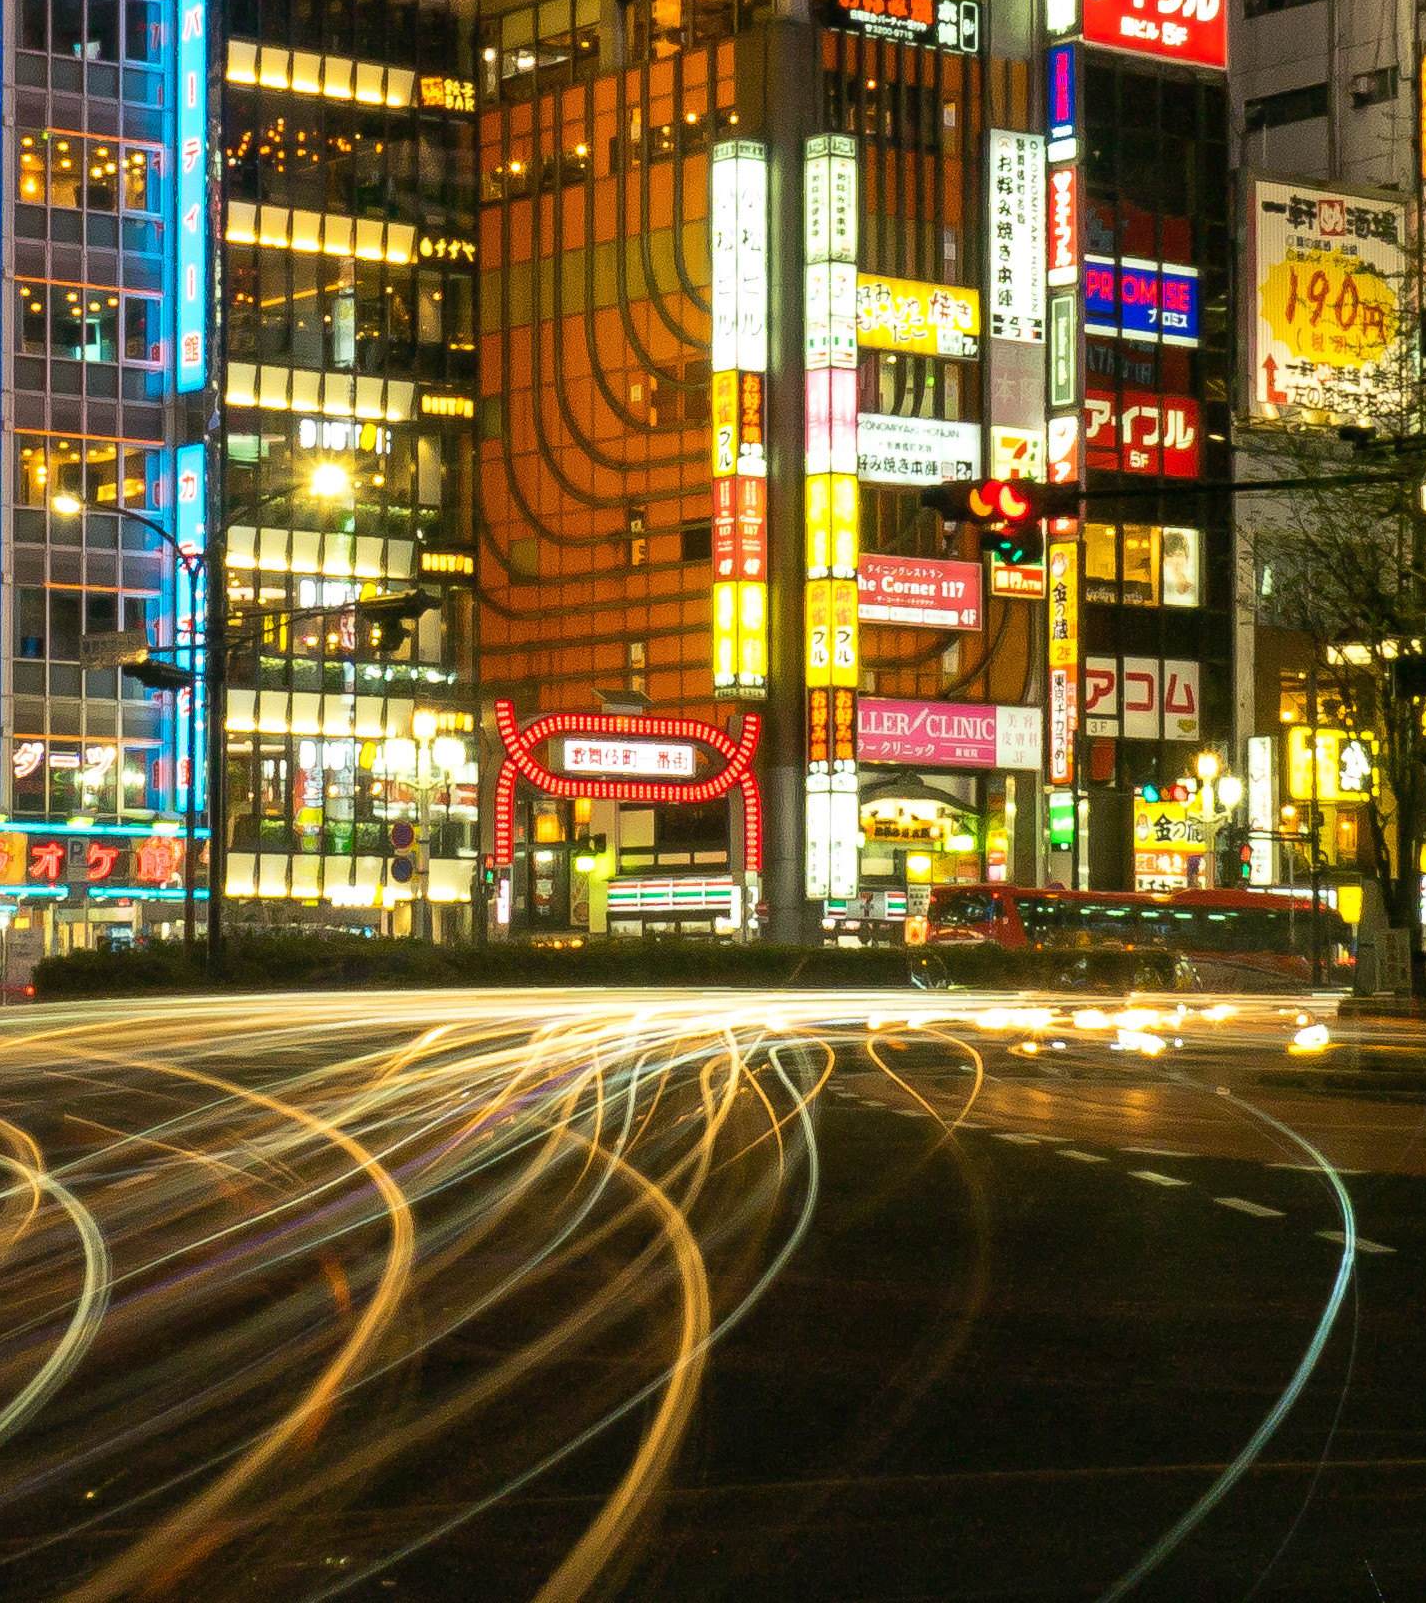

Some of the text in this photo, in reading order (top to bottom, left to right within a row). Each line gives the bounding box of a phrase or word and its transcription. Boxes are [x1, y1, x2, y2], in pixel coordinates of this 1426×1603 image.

[1086, 269, 1191, 313] PROMISE
[1084, 399, 1195, 451] アイフル
[867, 564, 944, 579] ダイニングレストラン
[881, 576, 937, 597] Corner
[941, 580, 967, 599] 117
[1084, 668, 1195, 714] アコム
[926, 714, 996, 741] CLINIC
[1090, 721, 1108, 734] 3F
[13, 741, 117, 779] ダーツ
[571, 746, 689, 771] 歌舞伎町一番街
